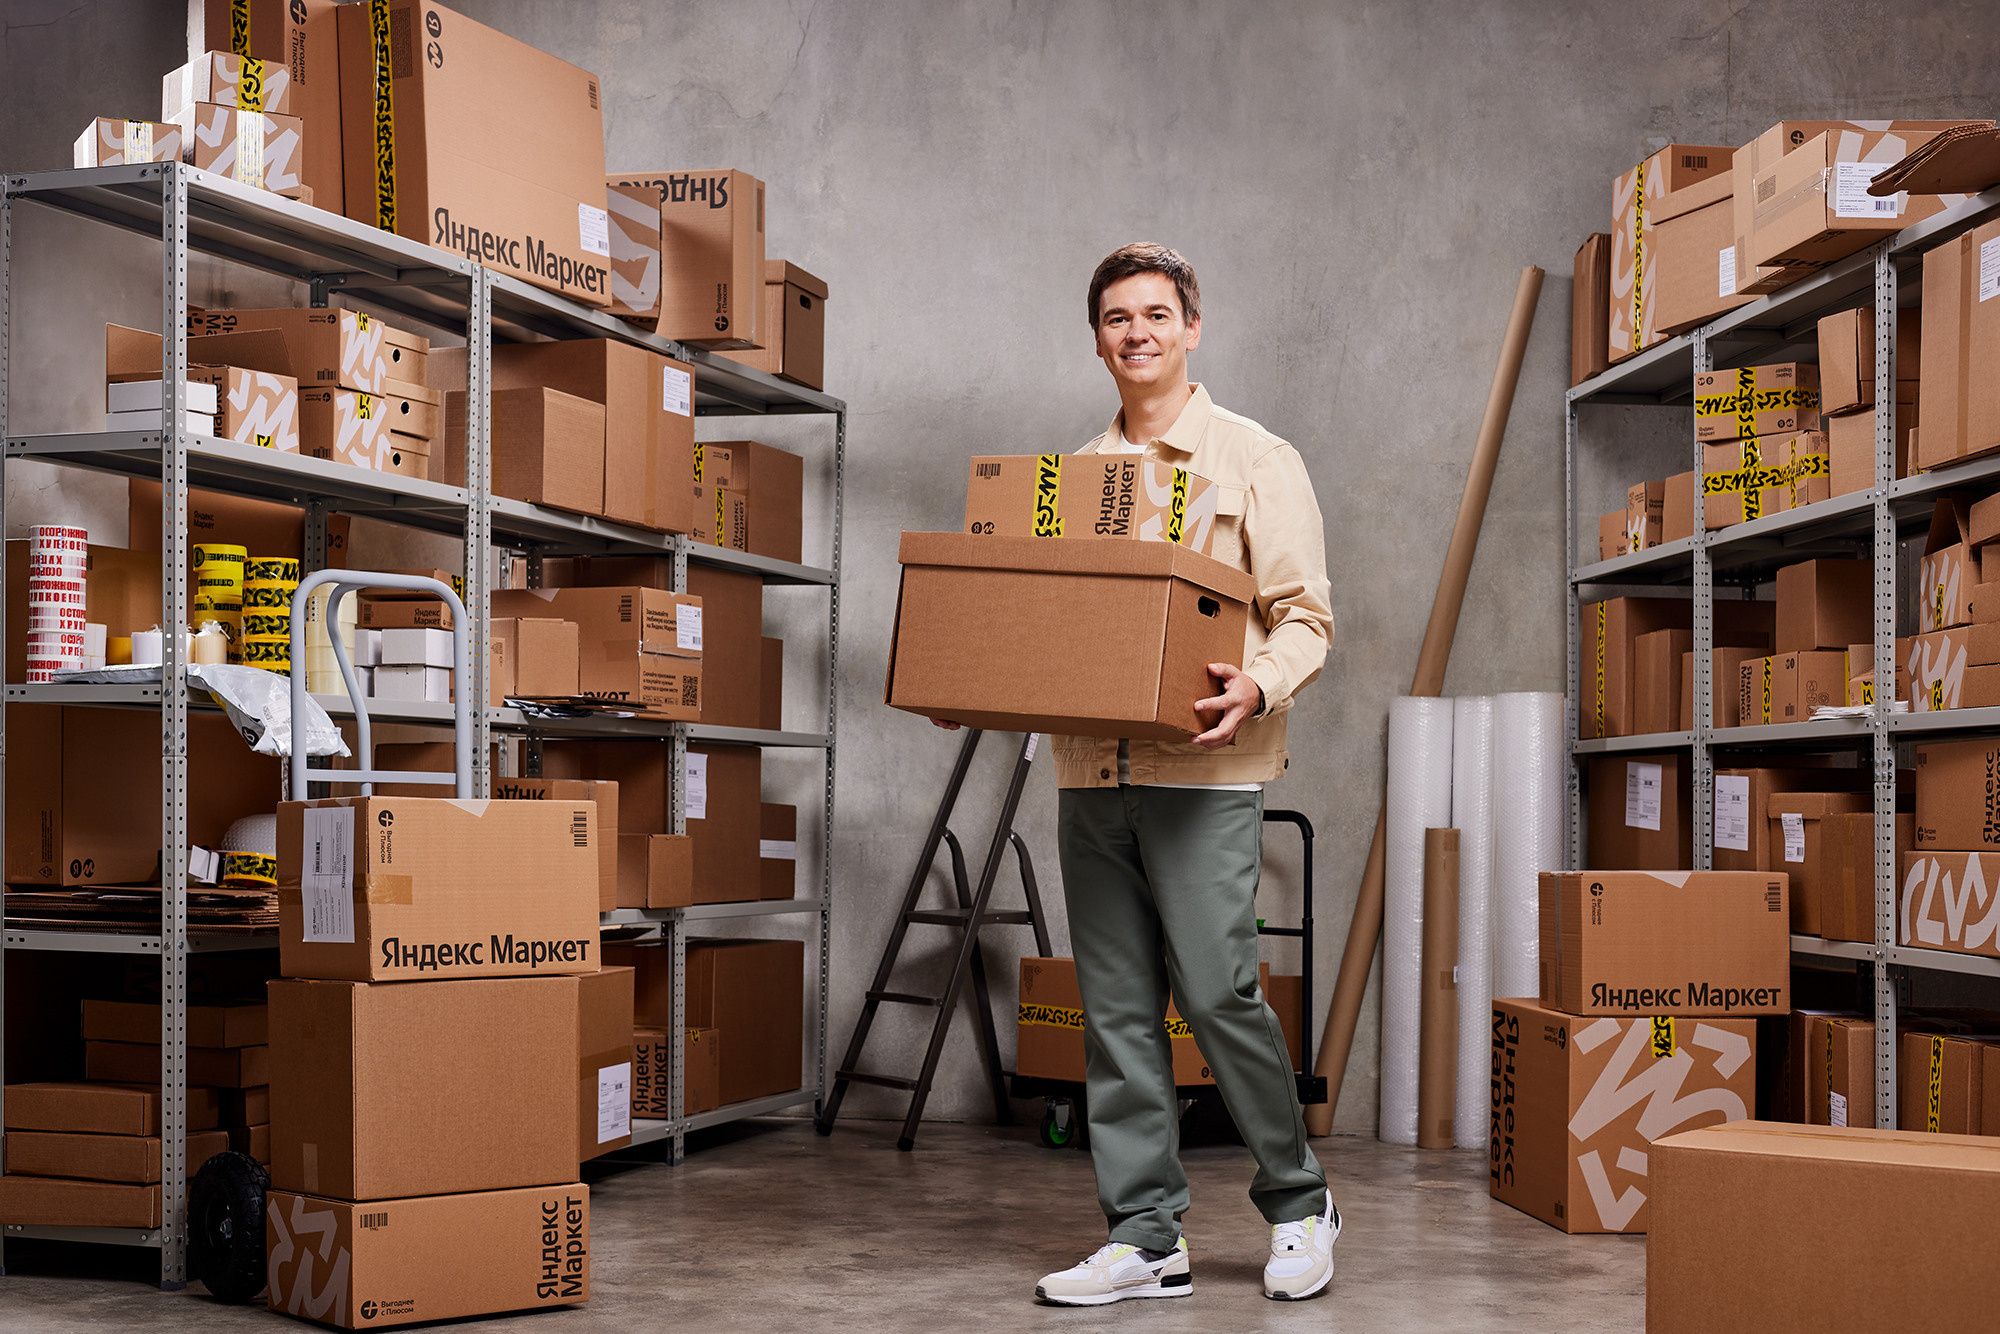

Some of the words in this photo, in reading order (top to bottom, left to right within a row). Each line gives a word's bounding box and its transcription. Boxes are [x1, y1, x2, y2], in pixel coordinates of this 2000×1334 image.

[619, 174, 728, 209] Янде
[434, 207, 521, 269] Яндекс
[525, 235, 608, 295] Маркет
[1095, 462, 1117, 534] Яндекс
[1112, 460, 1135, 535] Маркет
[414, 608, 440, 618] Яндекс
[414, 616, 440, 626] Маркет
[1983, 751, 1994, 843] Яндекс
[381, 937, 484, 972] Яндекс
[490, 934, 590, 968] Маркет
[1591, 983, 1681, 1010] Яндекс
[1688, 982, 1781, 1011] Маркет
[632, 1043, 651, 1112] Яндекс
[651, 1042, 668, 1114] Маркет
[1490, 1009, 1506, 1189] Маркет
[1503, 1014, 1520, 1187] Яндекс
[536, 1200, 562, 1299] Яндекс
[560, 1195, 586, 1298] Маркет
[381, 1299, 415, 1308] Выгоднее
[386, 1307, 414, 1316] Плюсом
